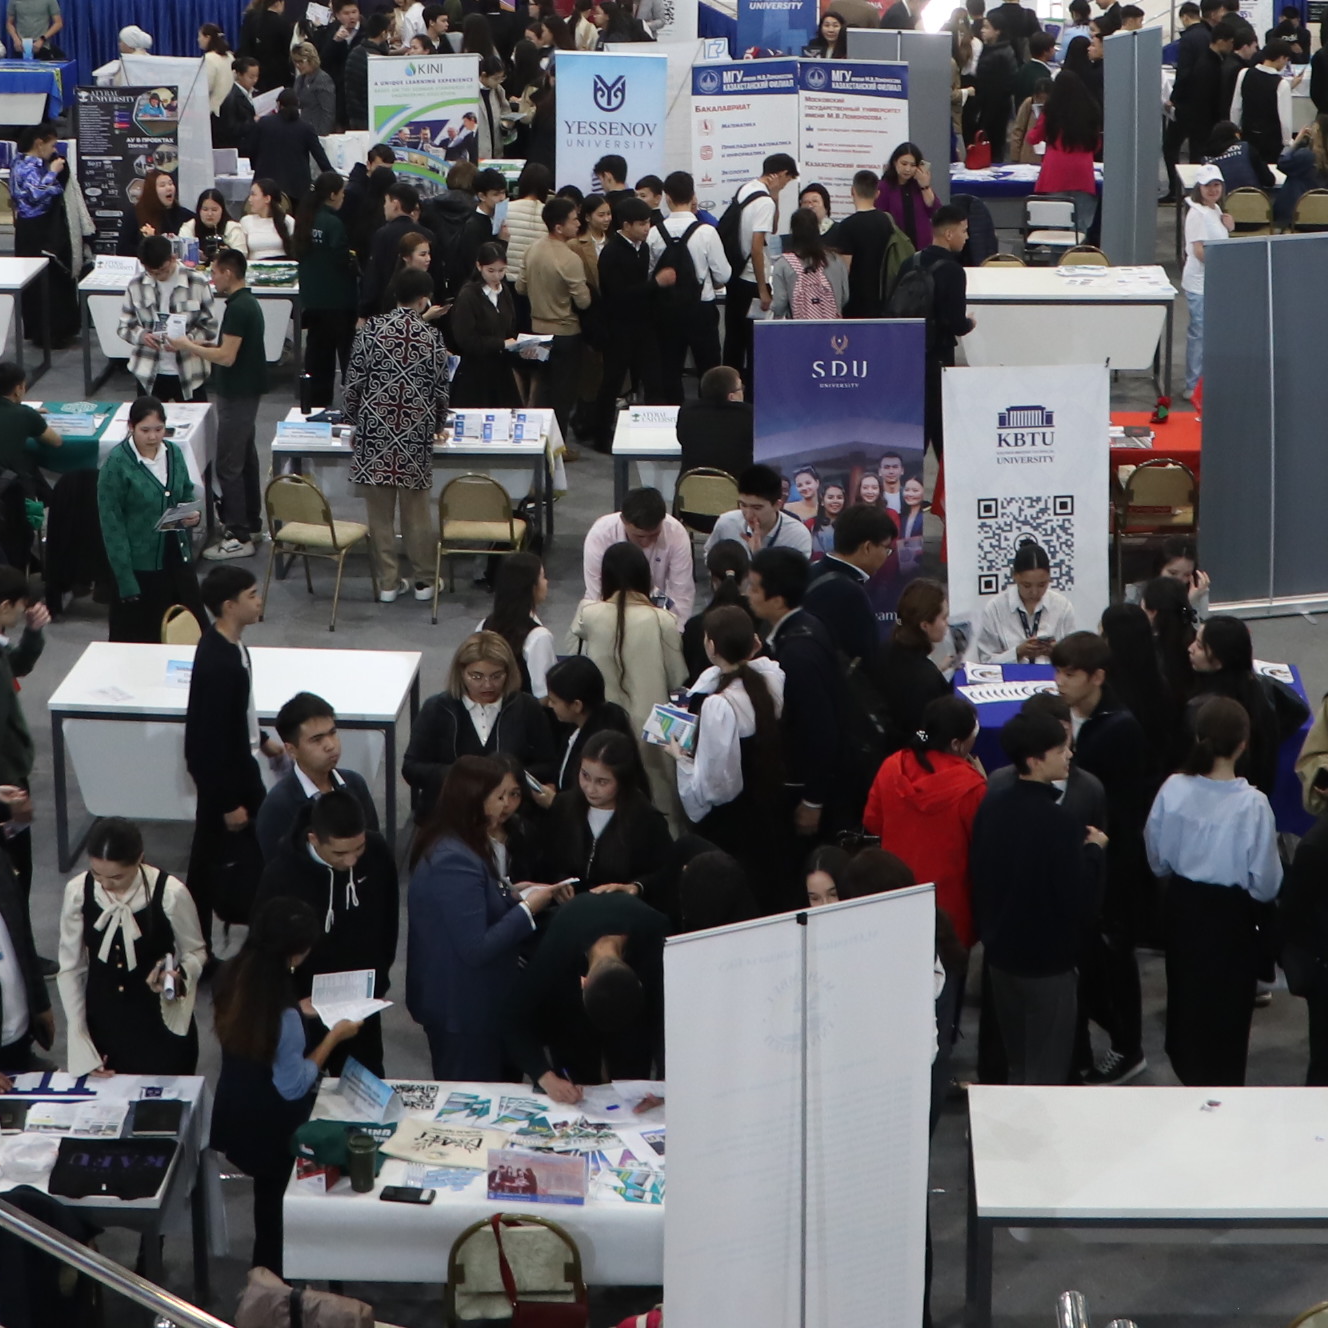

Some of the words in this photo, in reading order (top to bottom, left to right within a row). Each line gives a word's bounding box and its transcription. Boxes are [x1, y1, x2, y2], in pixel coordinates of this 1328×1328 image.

[749, 2, 803, 10] UNIVERSITY
[417, 63, 443, 75] KINI
[723, 70, 744, 83] МГУ
[831, 69, 852, 82] МГУ
[90, 95, 135, 103] UNIVERSITY
[564, 120, 657, 137] YESSENOV
[566, 139, 655, 150] UNIVERSITY
[812, 360, 868, 378] SDU
[997, 431, 1055, 448] KBTU
[997, 455, 1055, 465] UNIVERSITY
